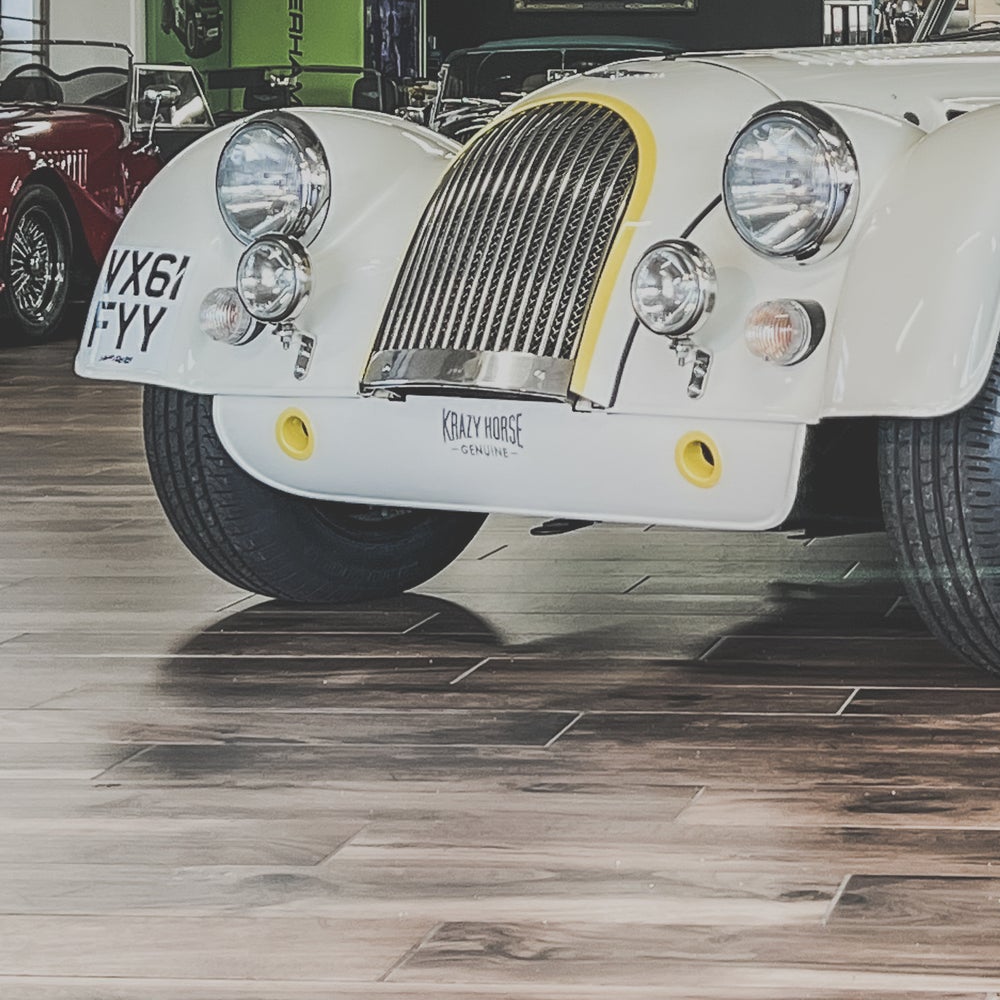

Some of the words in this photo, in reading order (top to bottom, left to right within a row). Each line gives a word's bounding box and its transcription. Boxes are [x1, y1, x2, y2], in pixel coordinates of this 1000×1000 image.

[103, 249, 191, 301] VX61
[87, 300, 168, 352] FYY
[442, 407, 482, 443] KRAZY
[484, 412, 524, 449] HORSE
[460, 444, 509, 458] GENUINE
